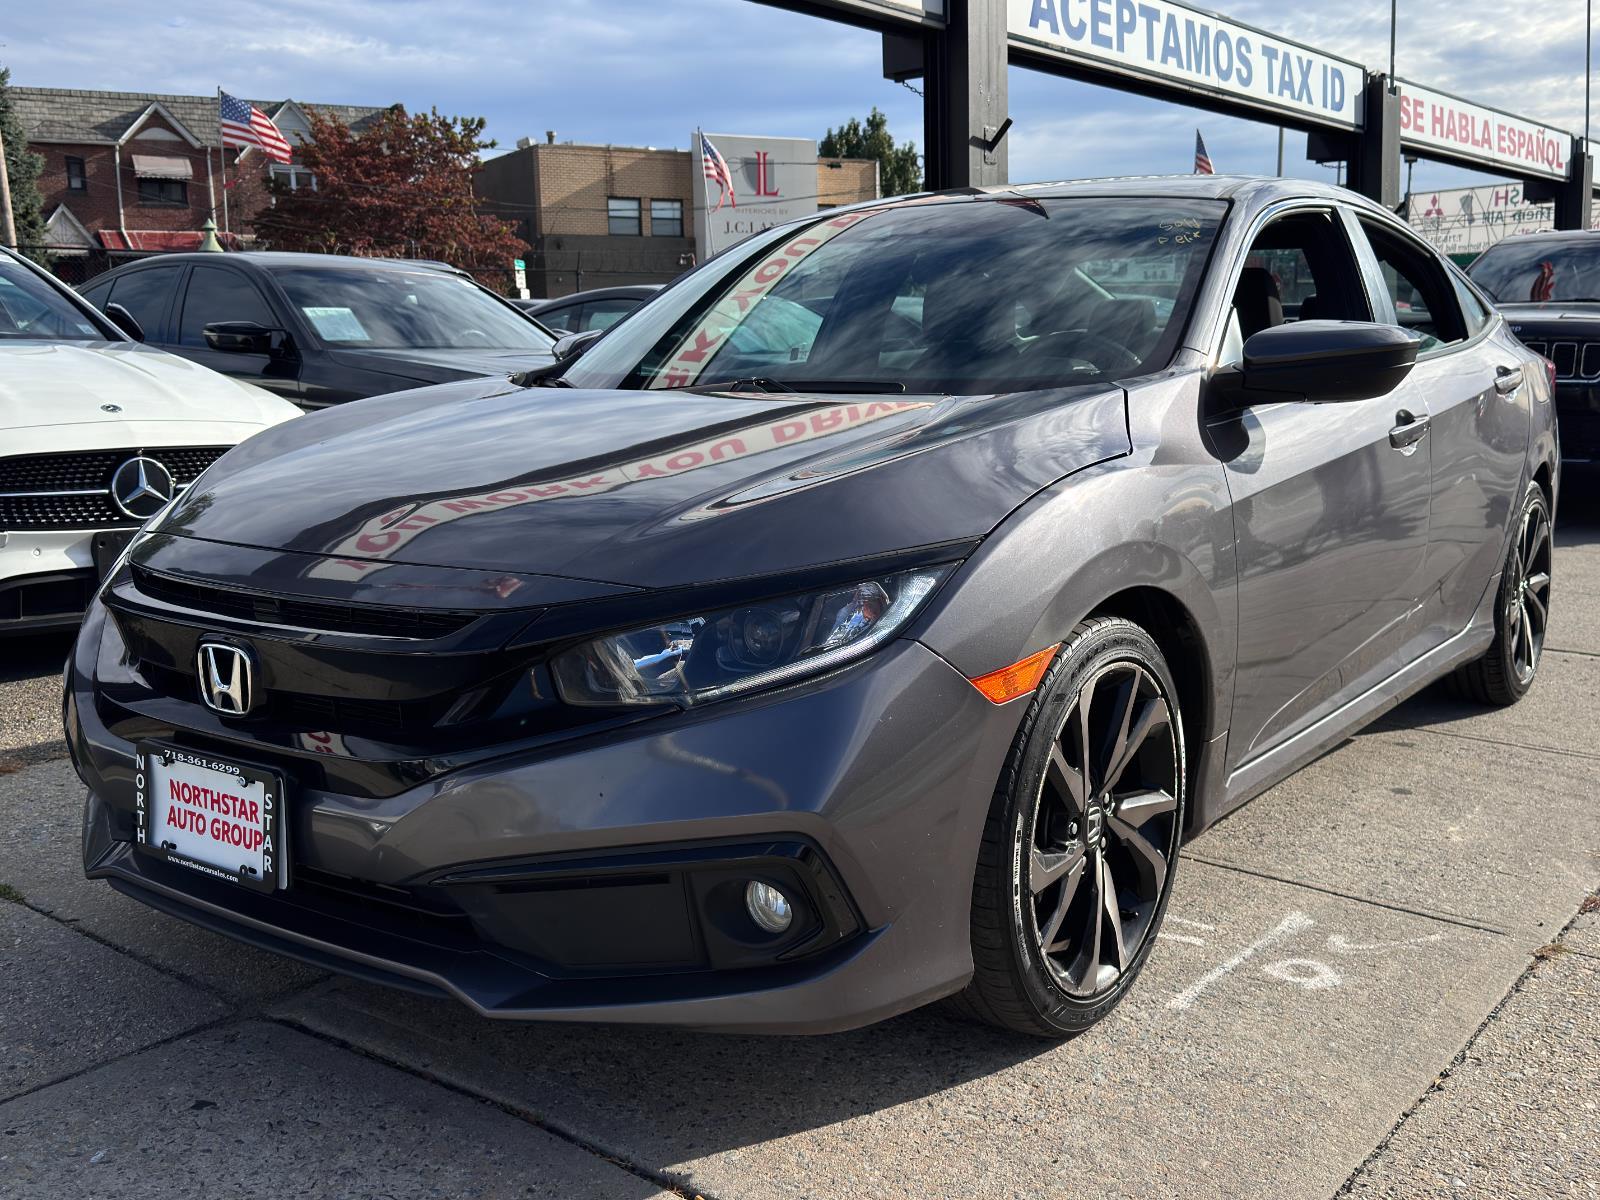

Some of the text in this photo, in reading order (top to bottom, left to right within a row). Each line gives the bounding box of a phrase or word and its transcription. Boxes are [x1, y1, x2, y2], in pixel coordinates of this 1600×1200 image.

[1029, 0, 1346, 113] ACEPTAMOS TAX ID
[1400, 94, 1564, 170] SE HABLA ESPAÑOL
[164, 750, 240, 775] 718-361-6299
[135, 754, 146, 844] NORTH
[167, 805, 264, 852] AUTO GROUP
[169, 778, 260, 825] NORTHSTAR
[263, 793, 273, 873] STAR
[167, 855, 239, 883] www.northstarcarsales.com
